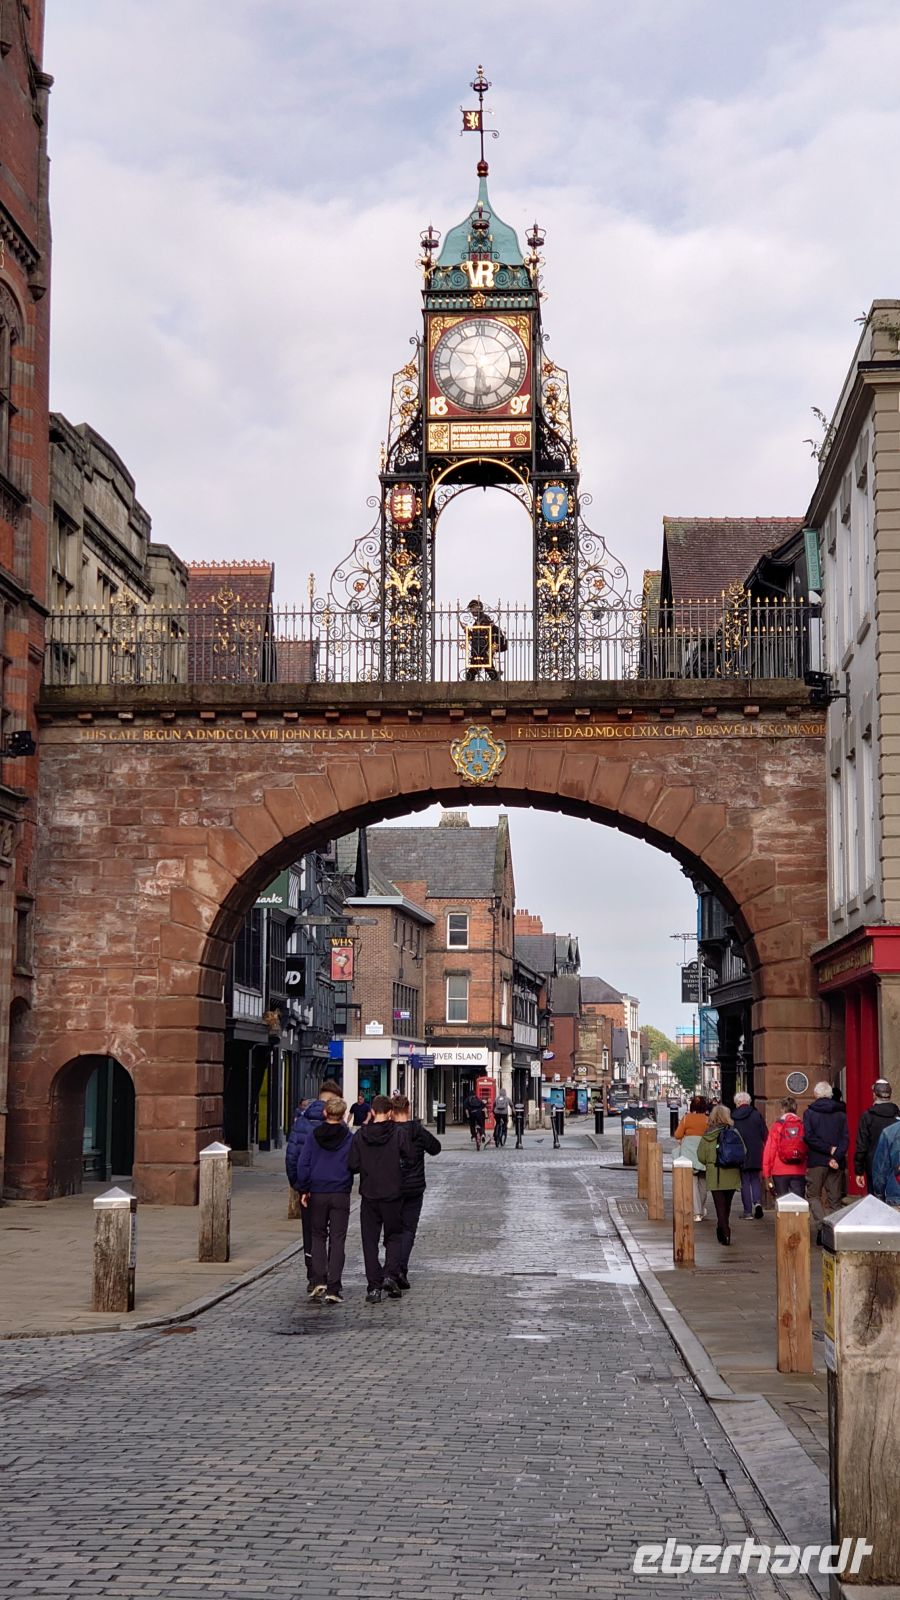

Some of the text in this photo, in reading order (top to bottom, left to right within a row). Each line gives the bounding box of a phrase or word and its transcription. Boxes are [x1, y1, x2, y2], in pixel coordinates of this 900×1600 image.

[465, 260, 495, 288] VR
[429, 394, 530, 415] 18 97
[143, 729, 181, 741] BEGUN
[282, 728, 311, 741] JOHN
[314, 728, 368, 740] KELSALL
[696, 724, 757, 736] BOSWELL
[331, 938, 353, 946] WHS
[432, 1052, 453, 1060] RIVER
[456, 1052, 483, 1060] ISLAND
